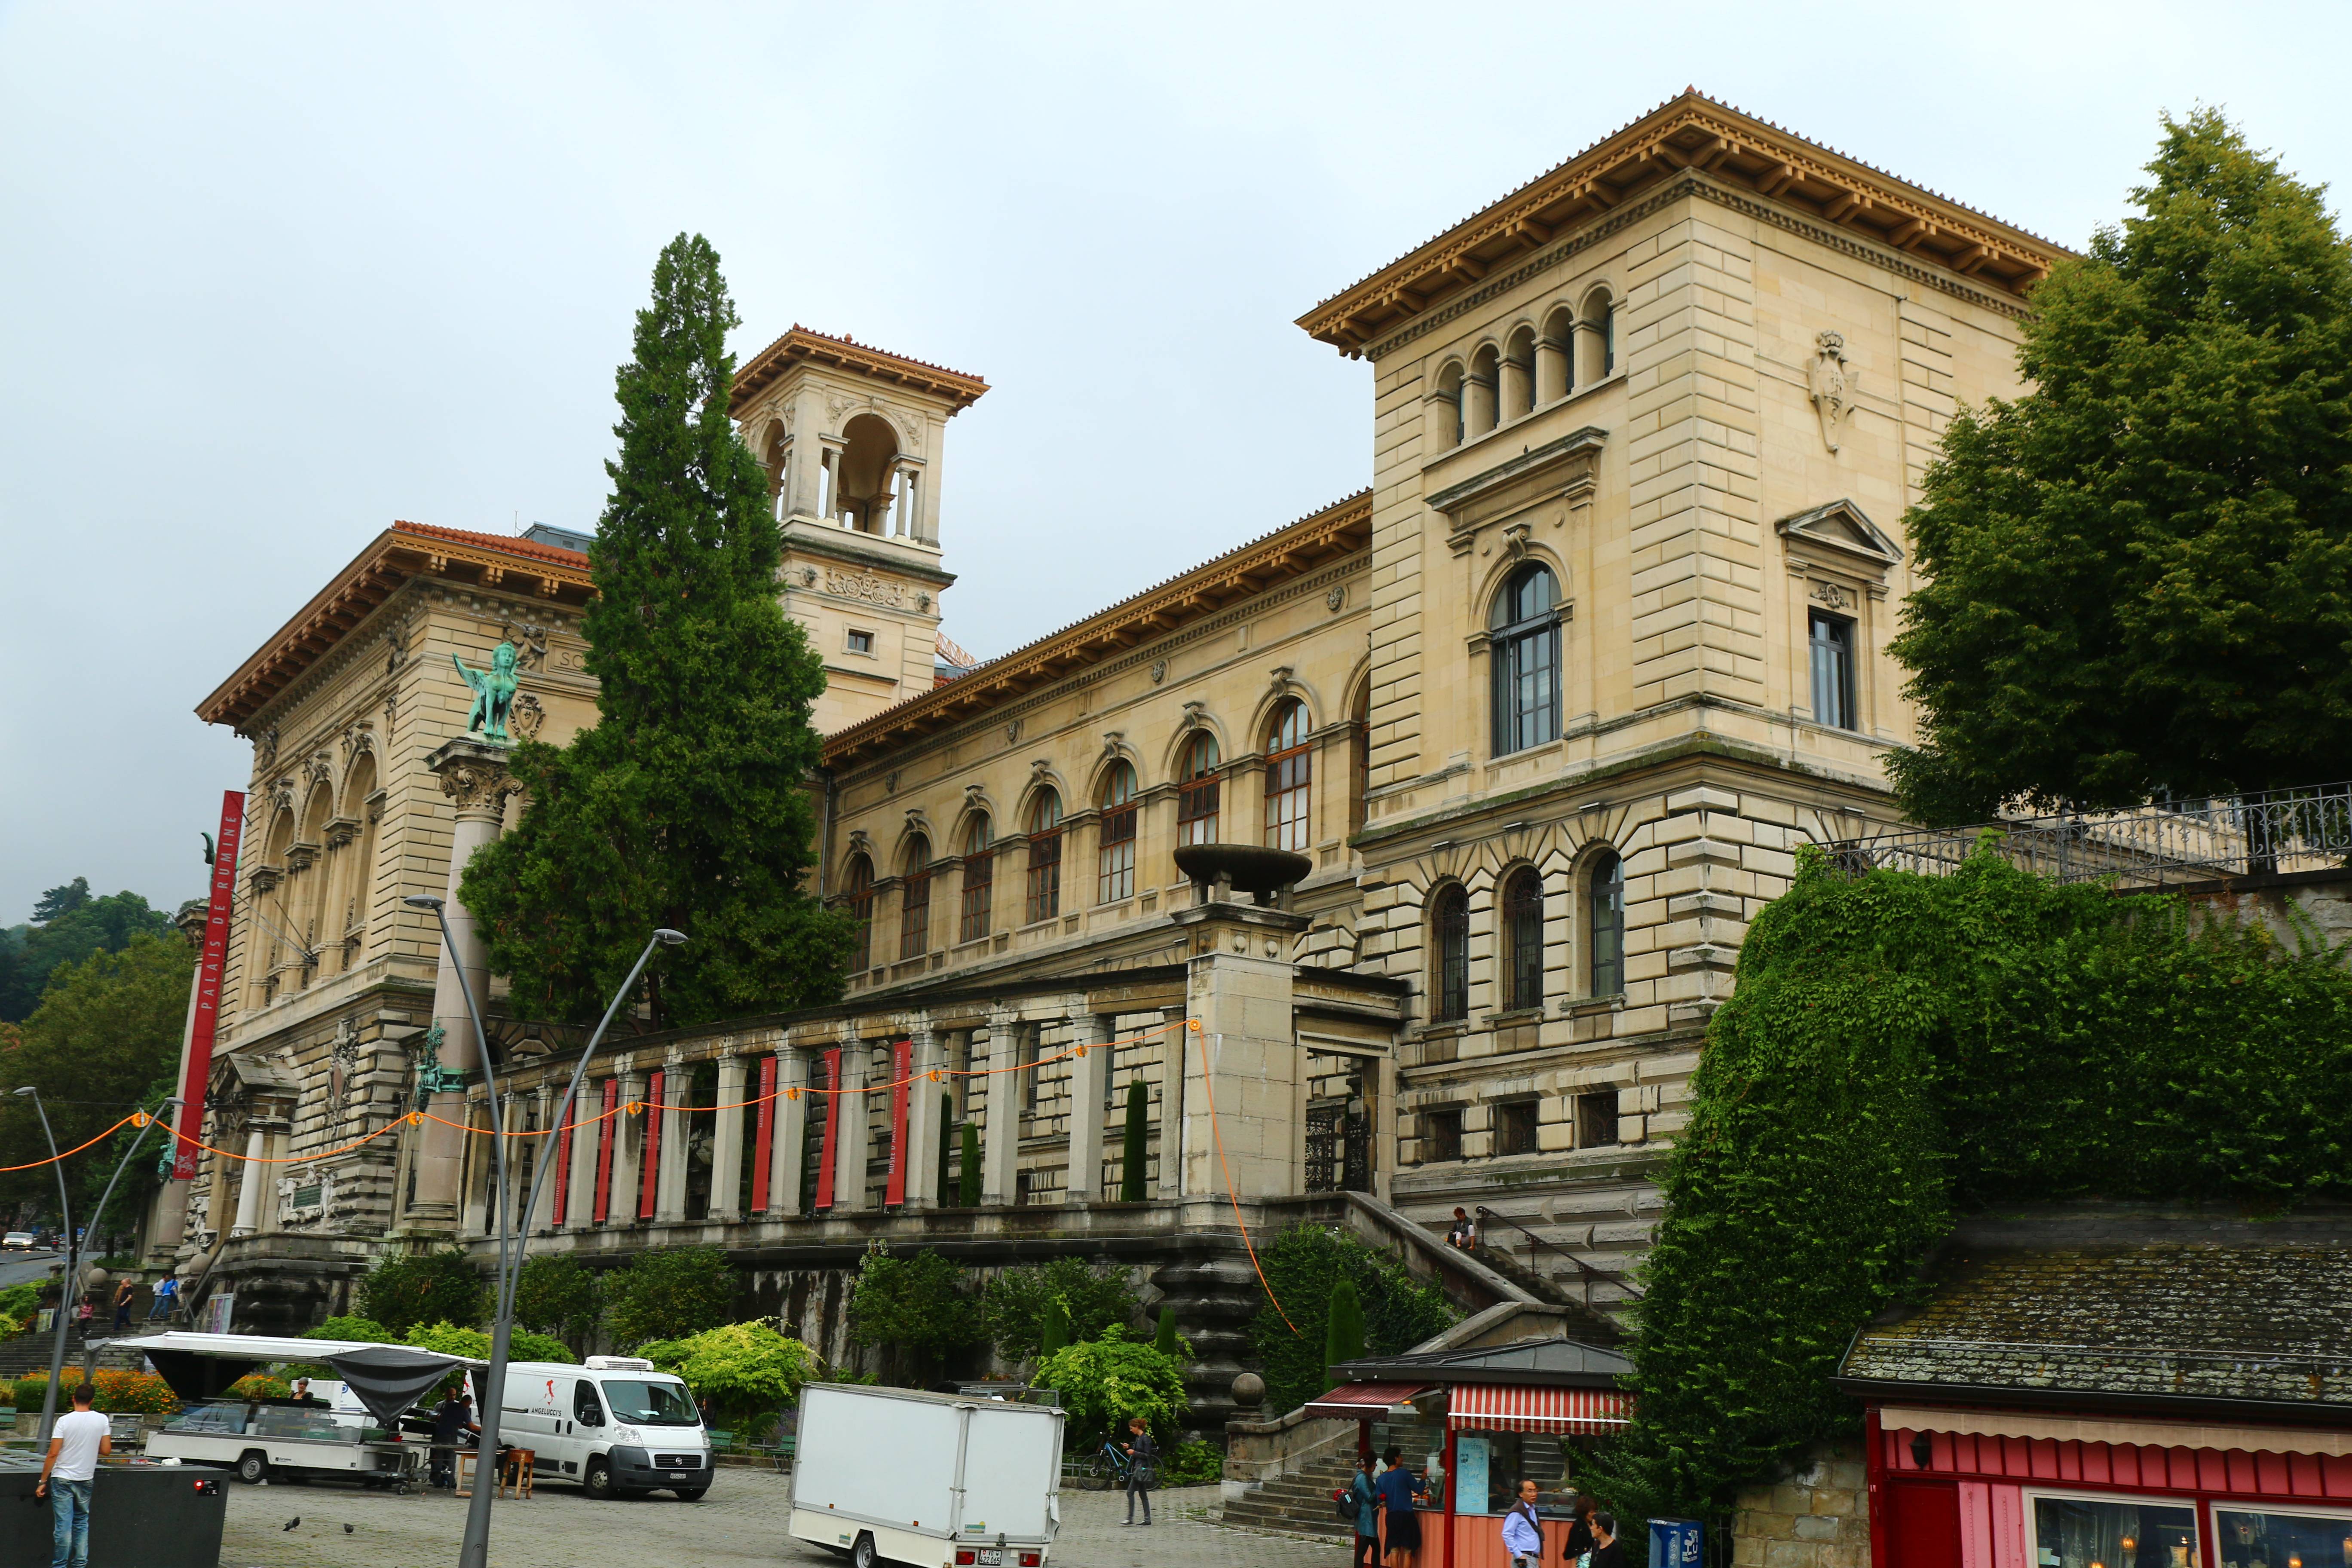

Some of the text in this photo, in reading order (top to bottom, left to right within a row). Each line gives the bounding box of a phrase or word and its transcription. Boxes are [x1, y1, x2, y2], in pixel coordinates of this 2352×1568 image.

[201, 816, 237, 1010] PALAIS DE RUMINE
[531, 1407, 562, 1416] ANGELUCCI'S
